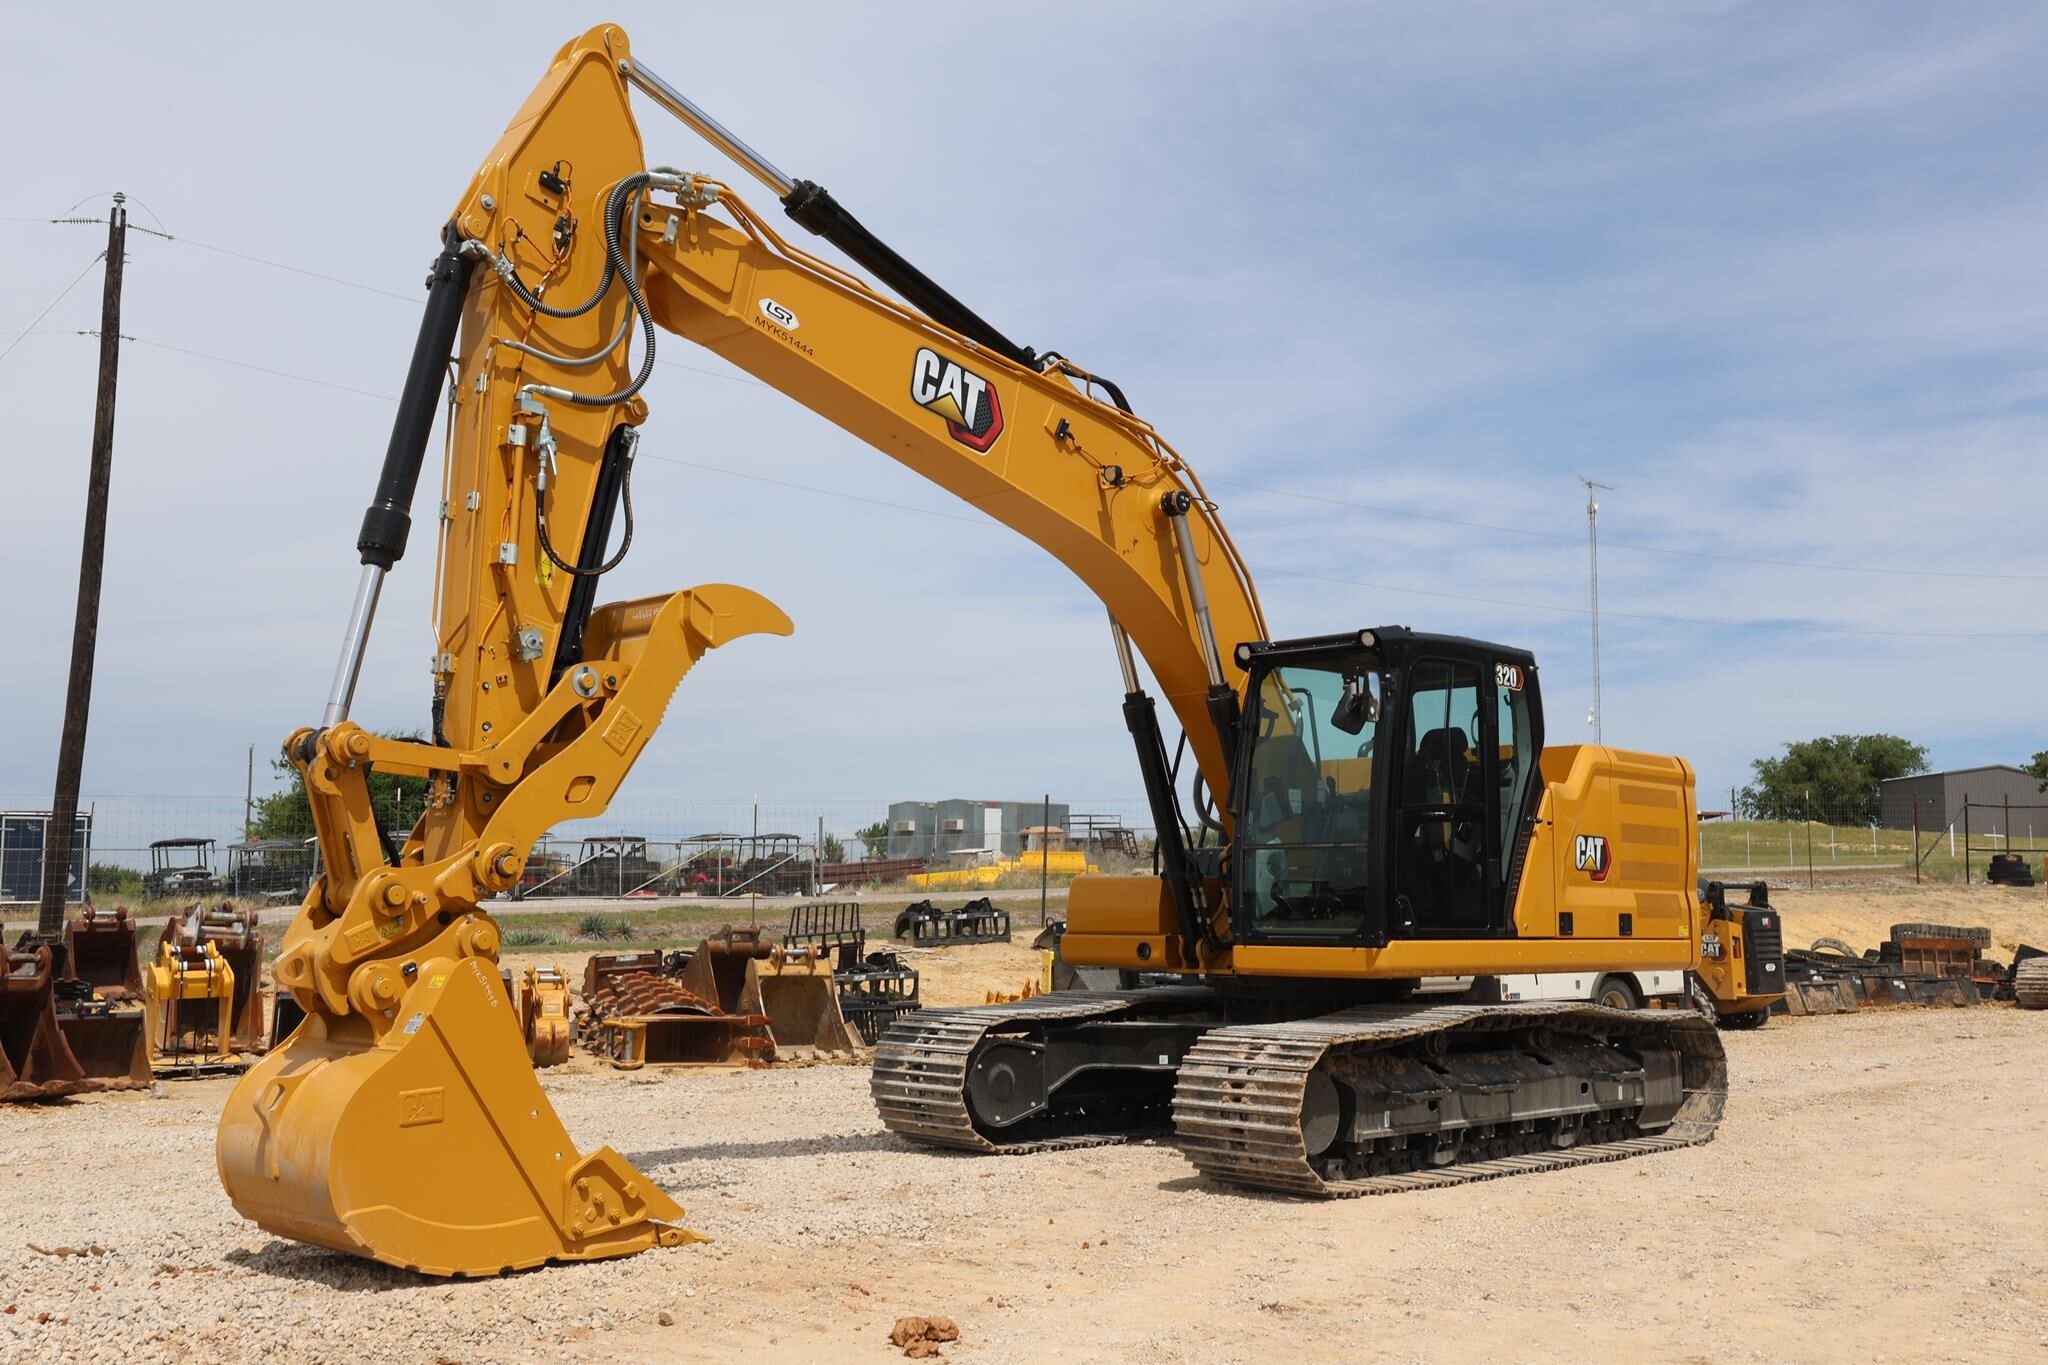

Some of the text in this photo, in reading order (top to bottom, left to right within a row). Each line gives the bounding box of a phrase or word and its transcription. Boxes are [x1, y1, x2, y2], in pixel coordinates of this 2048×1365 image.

[766, 301, 793, 325] LSR
[755, 316, 814, 356] MYK51444
[912, 348, 987, 430] CAT
[1496, 664, 1517, 687] 320
[1576, 836, 1604, 871] CAT
[1701, 943, 1720, 957] CAT
